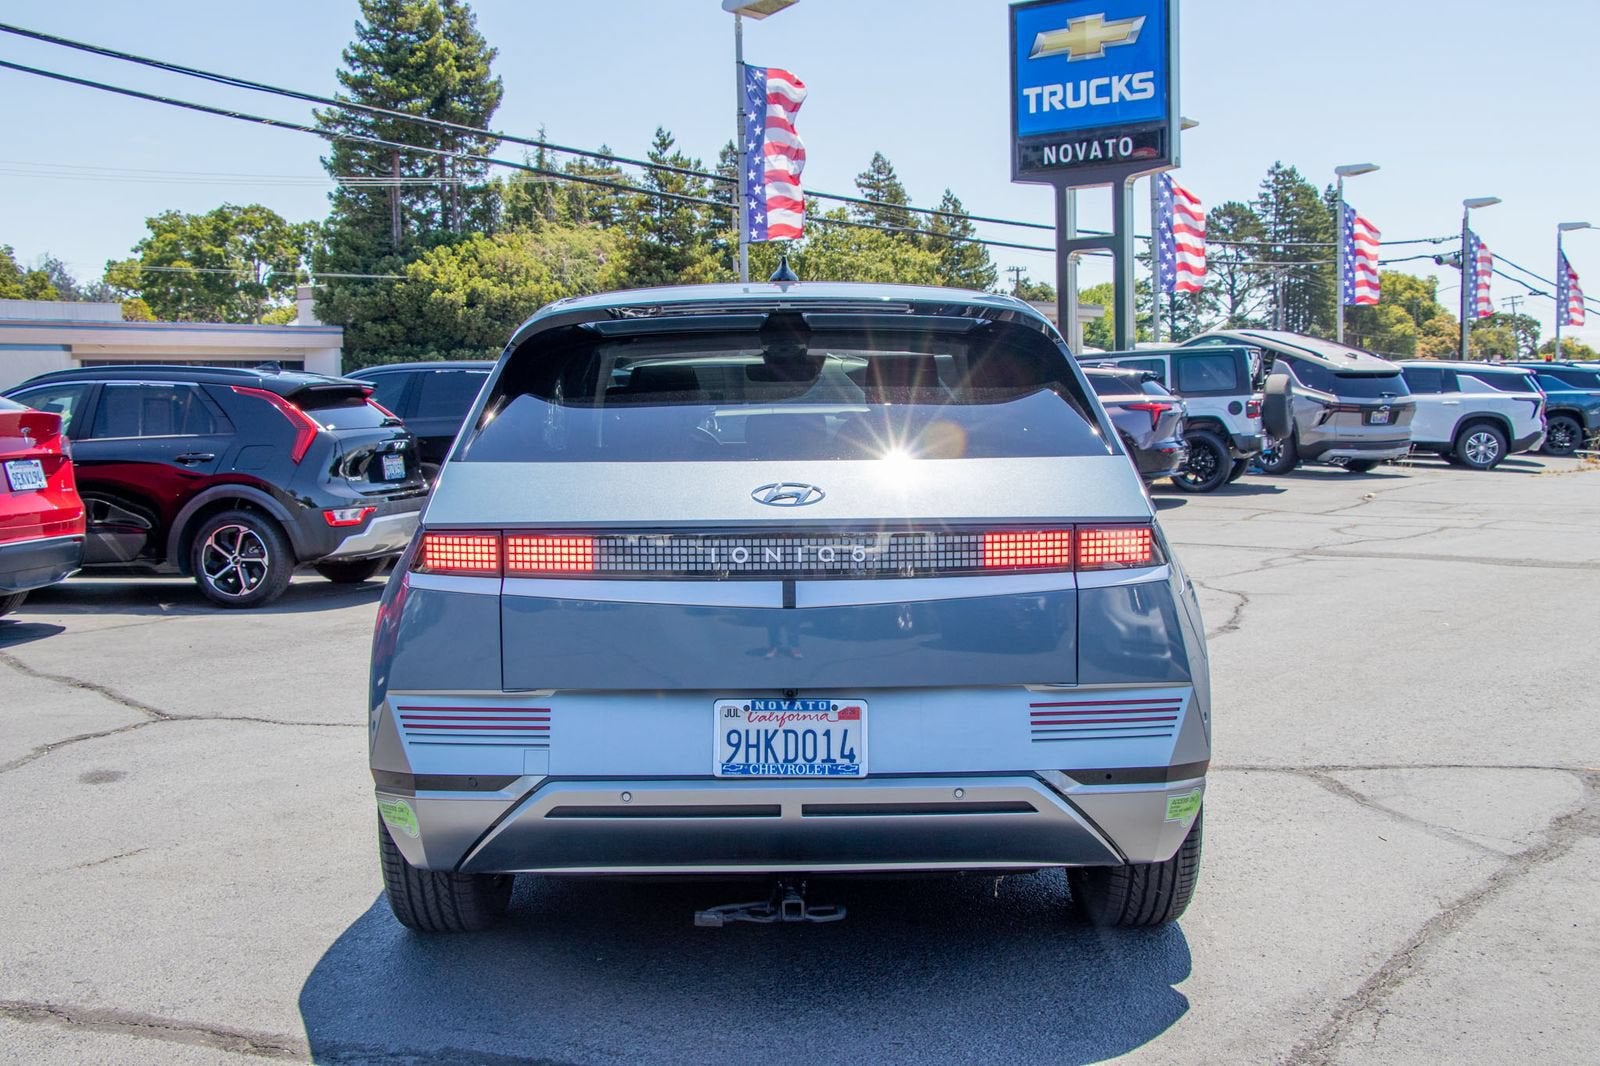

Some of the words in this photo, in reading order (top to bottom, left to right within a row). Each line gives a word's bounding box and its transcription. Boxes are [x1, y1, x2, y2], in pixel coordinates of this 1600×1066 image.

[1023, 71, 1155, 114] TRUCKS
[1043, 137, 1133, 165] NOVATO
[710, 546, 835, 563] IONIQ
[852, 546, 866, 562] 5
[724, 708, 741, 718] JUL
[755, 701, 827, 710] NOVATO
[747, 711, 839, 728] California
[726, 729, 856, 763] 9HKD014
[749, 764, 832, 775] CHEVROLET
